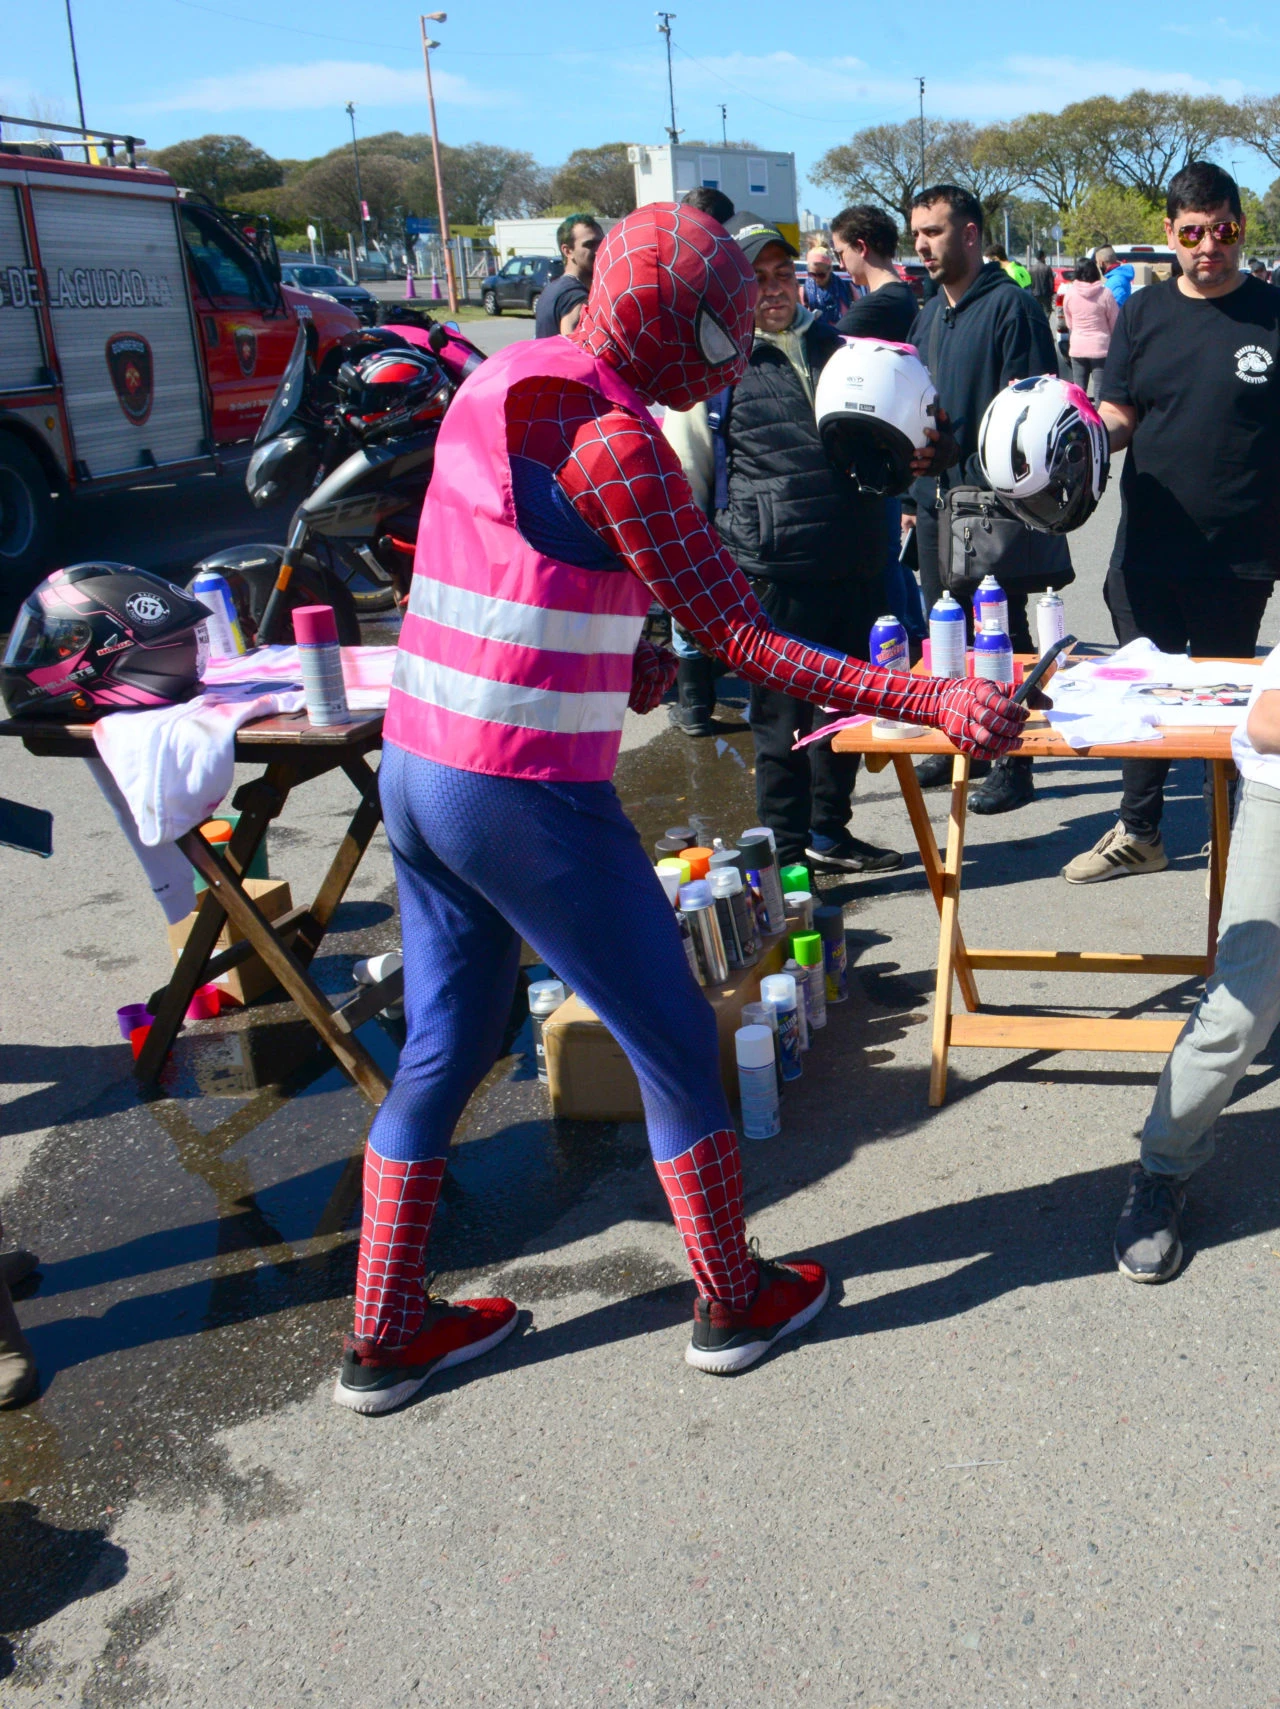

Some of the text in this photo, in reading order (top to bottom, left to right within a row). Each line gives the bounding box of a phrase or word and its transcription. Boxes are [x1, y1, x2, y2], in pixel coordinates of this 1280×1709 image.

[7, 267, 41, 308] DE
[72, 267, 147, 308] CIUDAD
[1235, 370, 1268, 384] ARGENTINA
[136, 600, 160, 616] 67
[97, 640, 134, 655] HONDA
